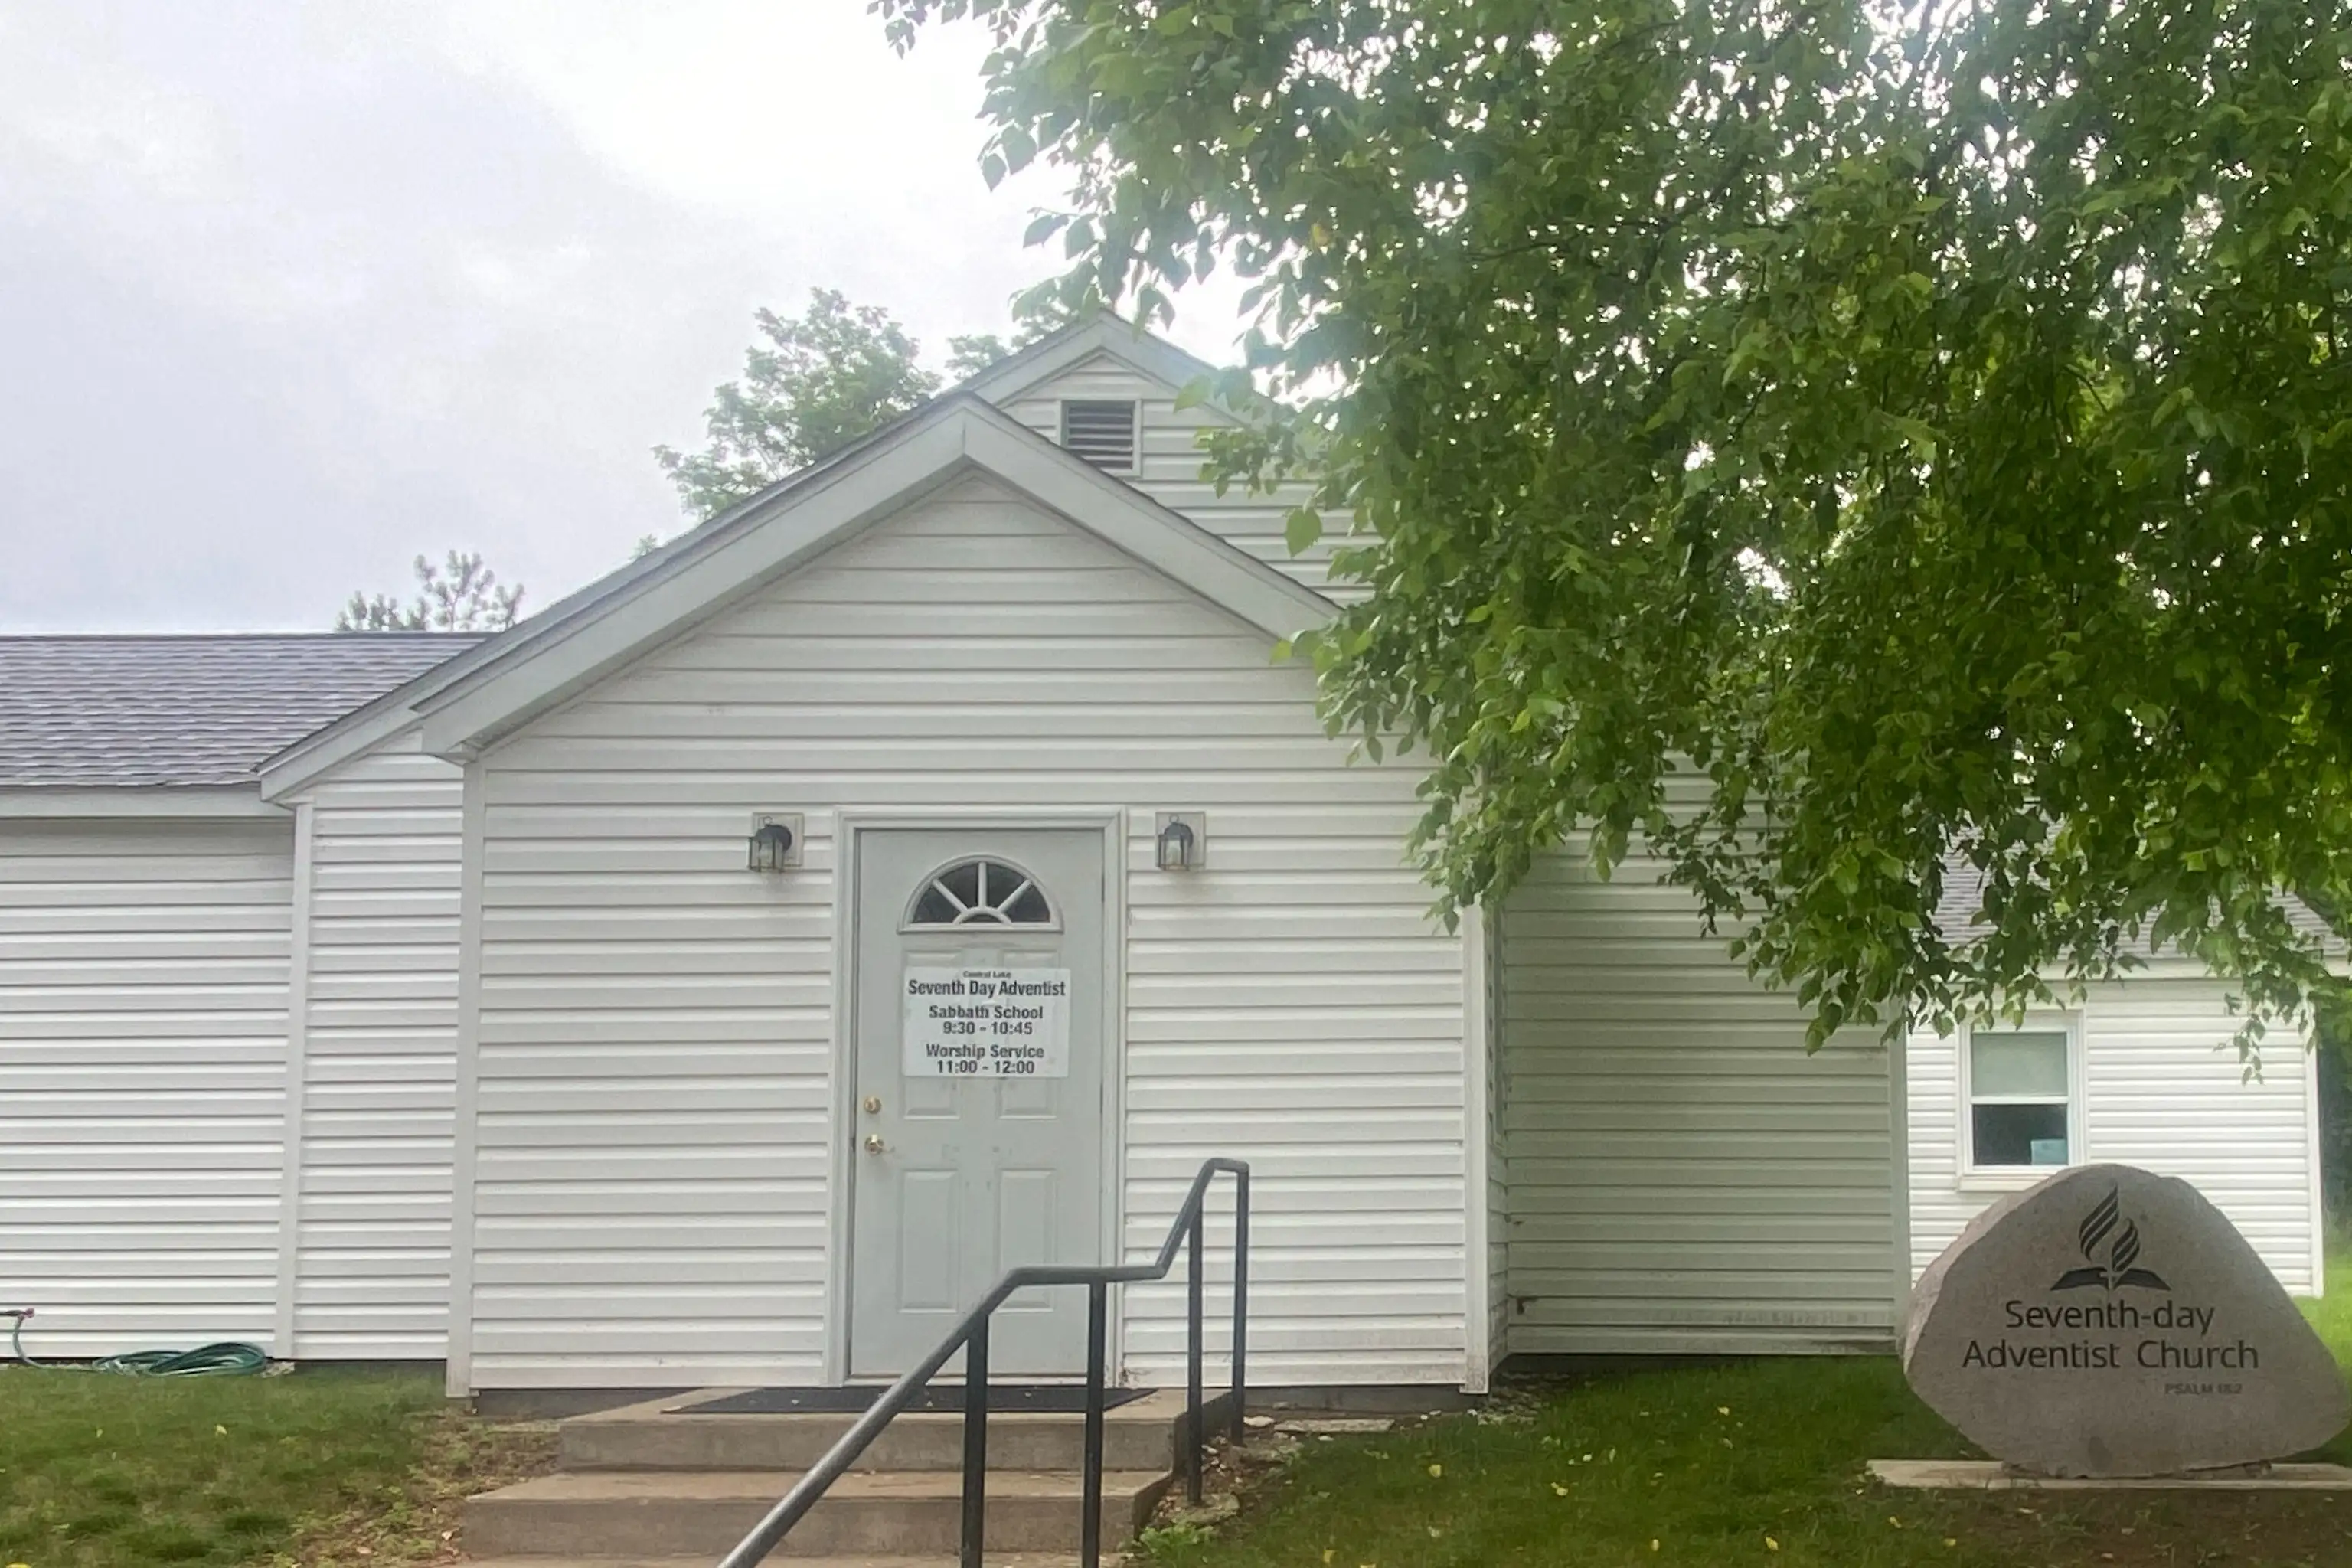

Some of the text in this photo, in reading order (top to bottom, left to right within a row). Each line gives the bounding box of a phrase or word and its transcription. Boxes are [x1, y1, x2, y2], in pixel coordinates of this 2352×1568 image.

[908, 980, 1066, 998] Seventh Day Adventist
[929, 1005, 1044, 1019] Sabbath School
[942, 1021, 975, 1034] 9:30
[991, 1022, 1033, 1034] 10:45
[926, 1044, 1044, 1060] Worship Service
[937, 1060, 978, 1073] 11:00
[995, 1061, 1035, 1073] 12:00
[2004, 1299, 2215, 1335] Seventh-day
[1962, 1340, 2259, 1369] Adventist Church
[2164, 1383, 2213, 1396] PSALM
